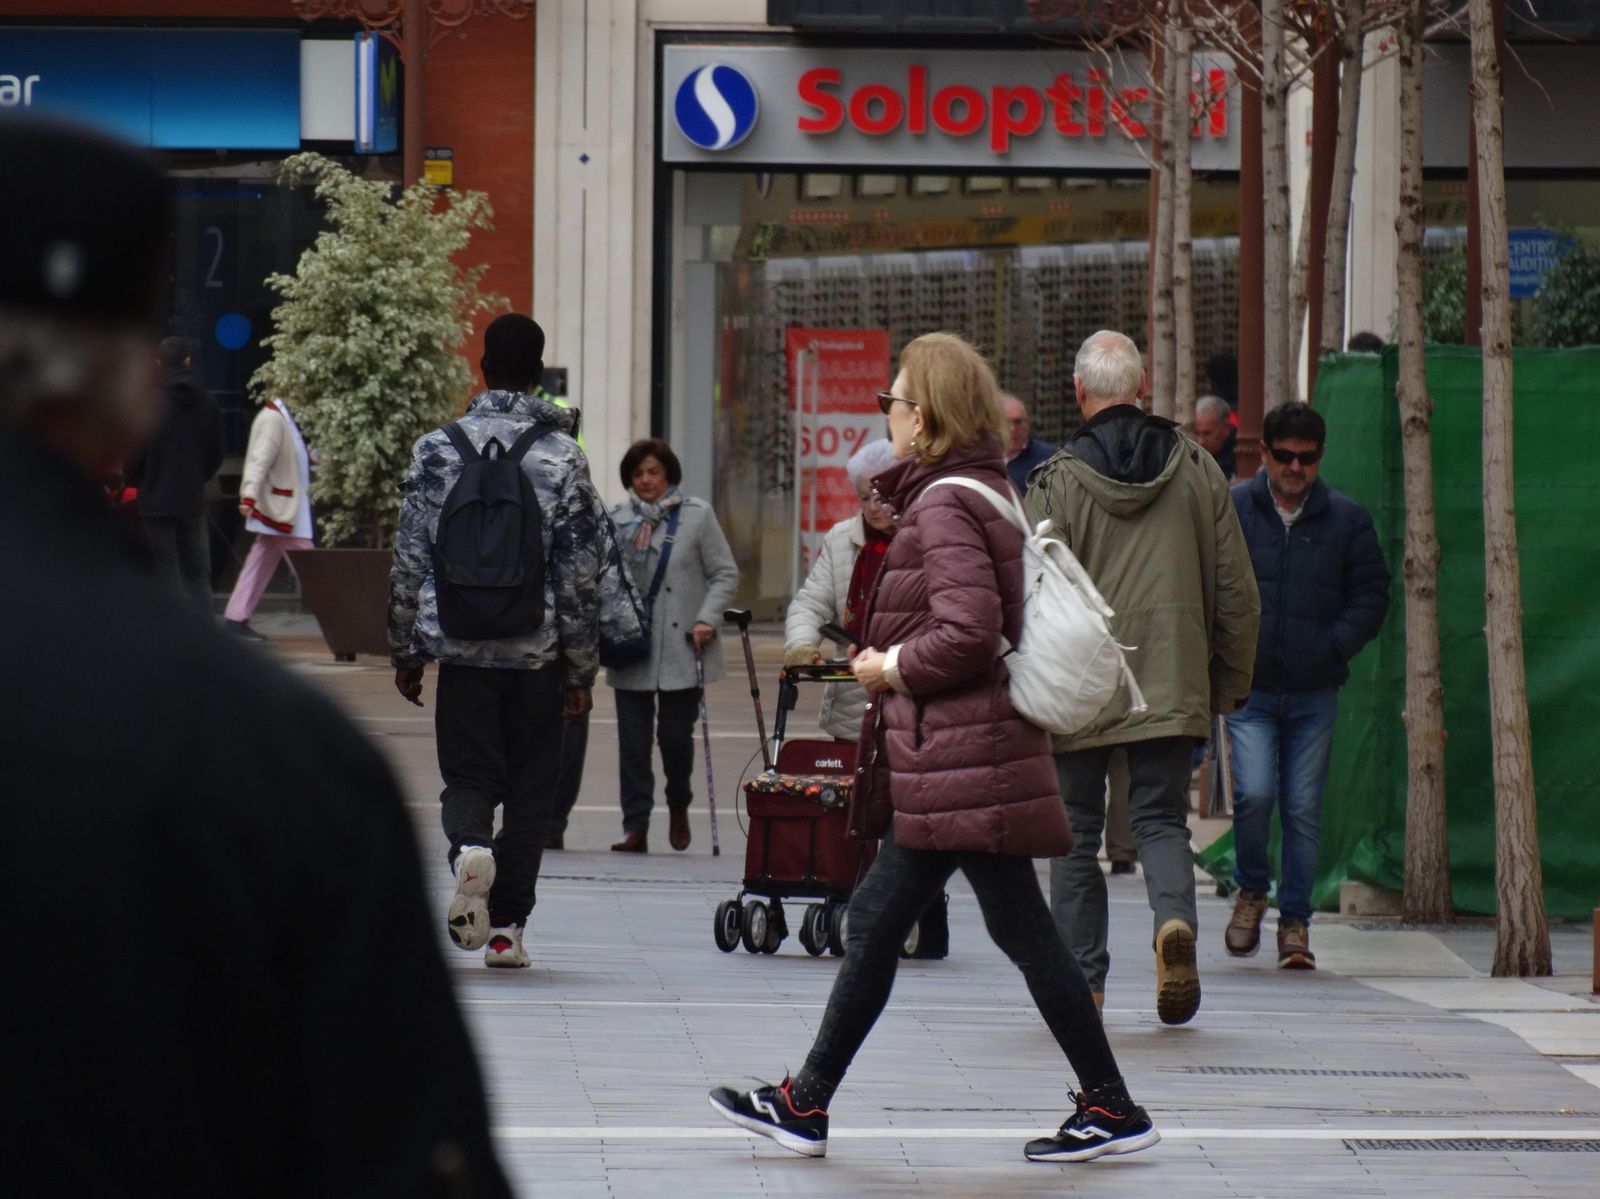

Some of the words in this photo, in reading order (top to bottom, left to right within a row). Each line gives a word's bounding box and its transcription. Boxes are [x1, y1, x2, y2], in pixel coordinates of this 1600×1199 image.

[0, 75, 40, 106] ar
[797, 65, 1227, 153] Solopticl
[205, 226, 223, 288] 2
